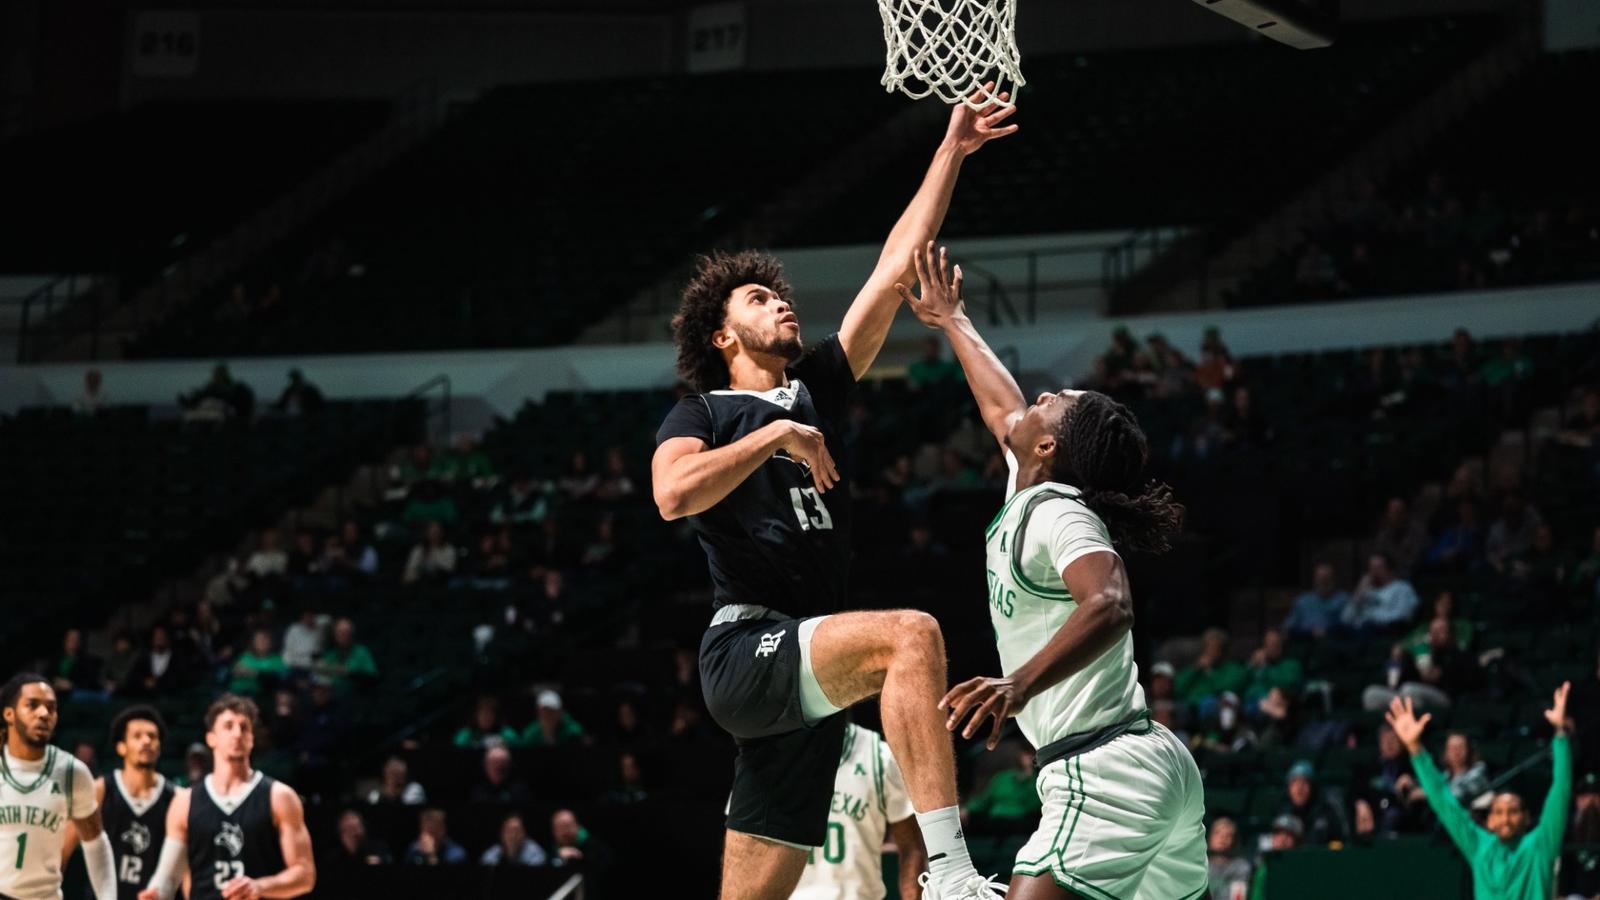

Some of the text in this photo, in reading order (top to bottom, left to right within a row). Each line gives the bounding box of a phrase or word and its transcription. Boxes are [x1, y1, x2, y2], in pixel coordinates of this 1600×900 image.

[789, 486, 834, 532] 13
[0, 804, 21, 825] RTH
[831, 790, 870, 821] EXAS
[16, 832, 27, 869] 1
[120, 855, 142, 884] 12
